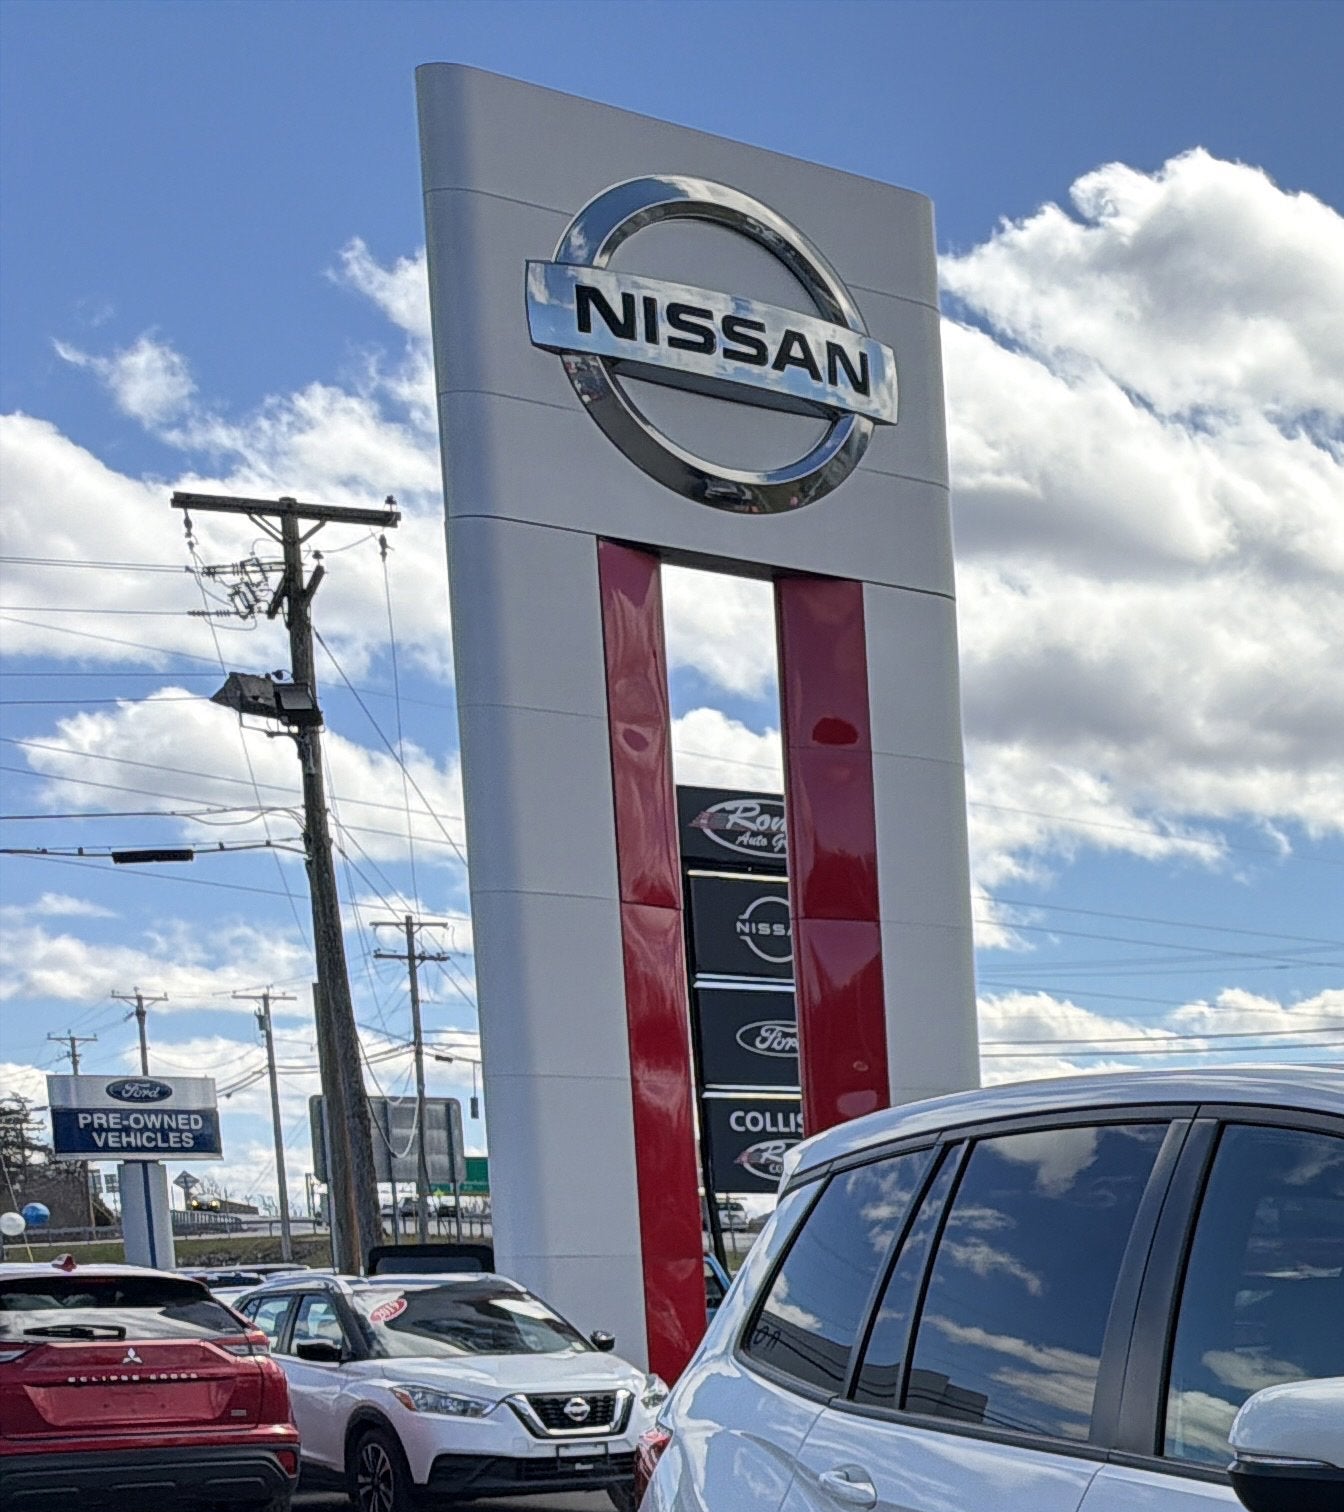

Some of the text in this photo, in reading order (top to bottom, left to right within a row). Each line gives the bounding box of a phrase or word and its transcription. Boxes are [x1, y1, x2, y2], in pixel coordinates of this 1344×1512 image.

[575, 284, 871, 397] NISSAN
[736, 831, 768, 847] Auto
[736, 921, 791, 936] NISS
[755, 1025, 798, 1051] For
[121, 1082, 160, 1099] Ford
[78, 1112, 204, 1131] PRE-OWNED
[729, 1110, 803, 1133] COLLIS
[91, 1131, 195, 1149] VEHICLES
